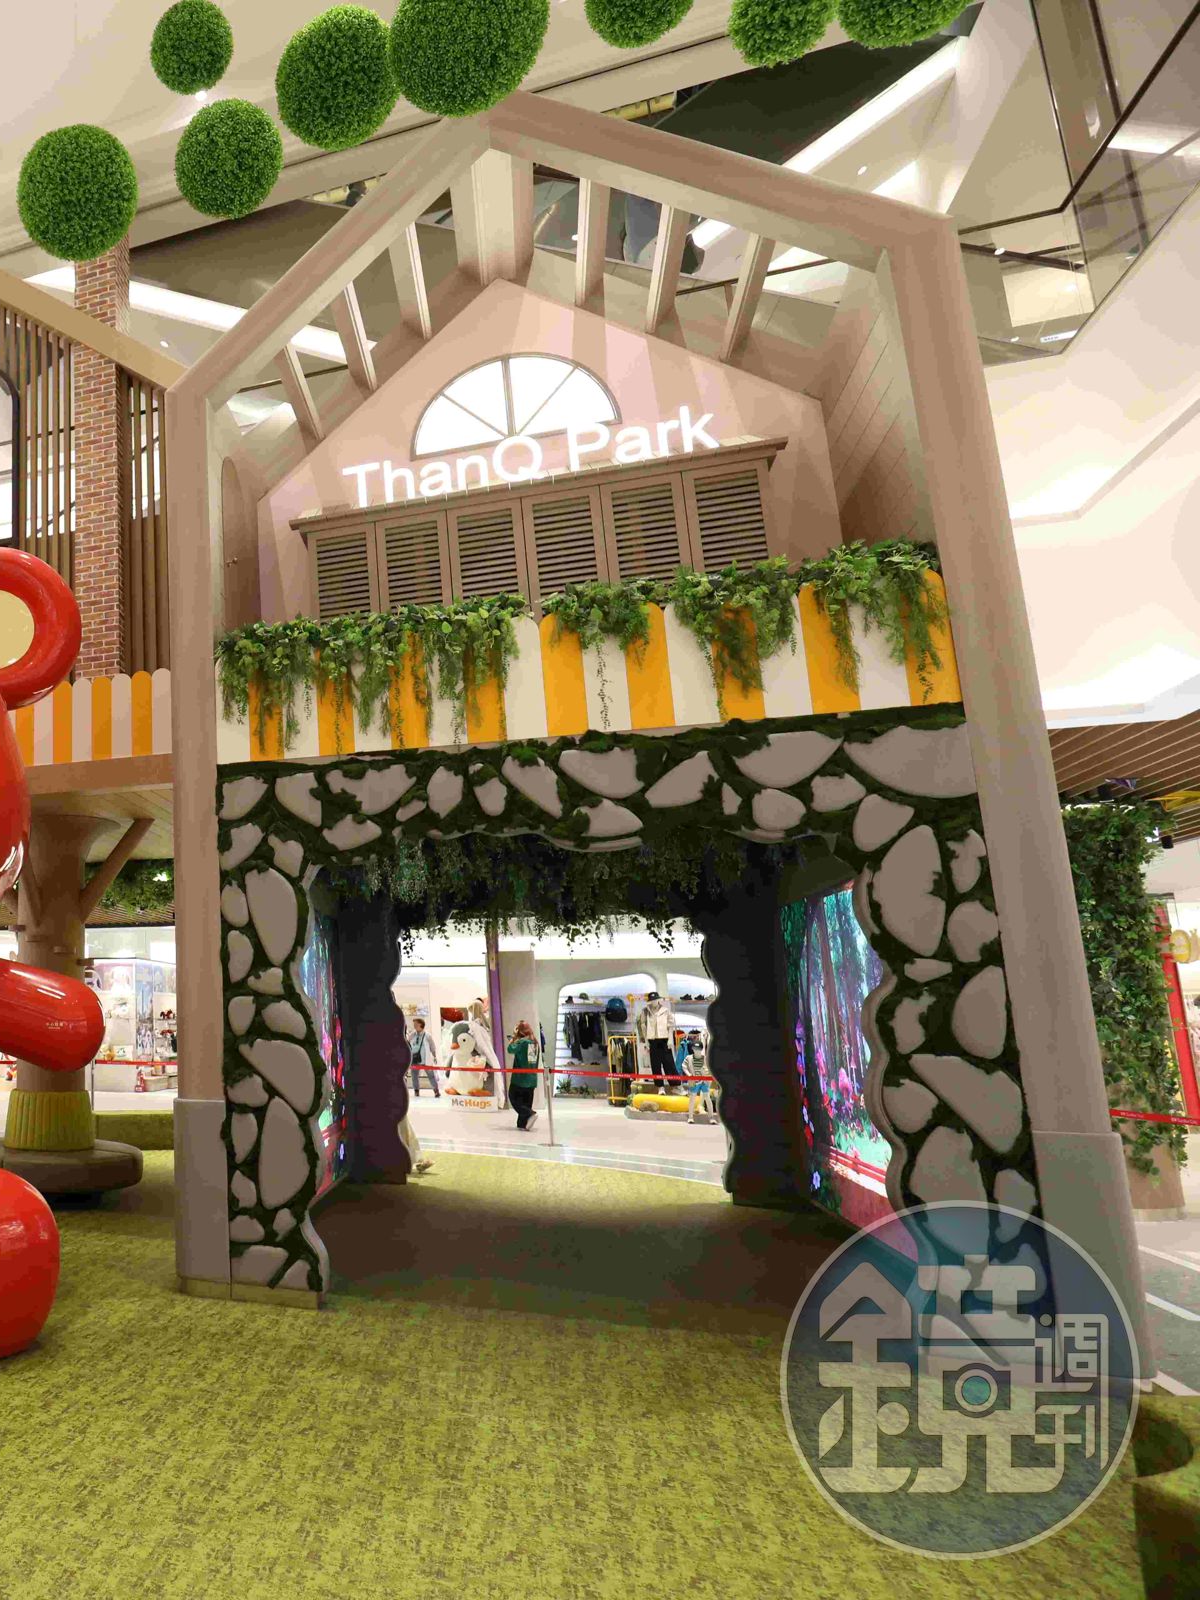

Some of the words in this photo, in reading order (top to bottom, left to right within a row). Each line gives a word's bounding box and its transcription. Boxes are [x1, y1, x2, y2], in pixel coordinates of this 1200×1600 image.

[342, 433, 546, 508] ThanQ
[566, 406, 720, 472] Park
[452, 1098, 492, 1109] McHugs
